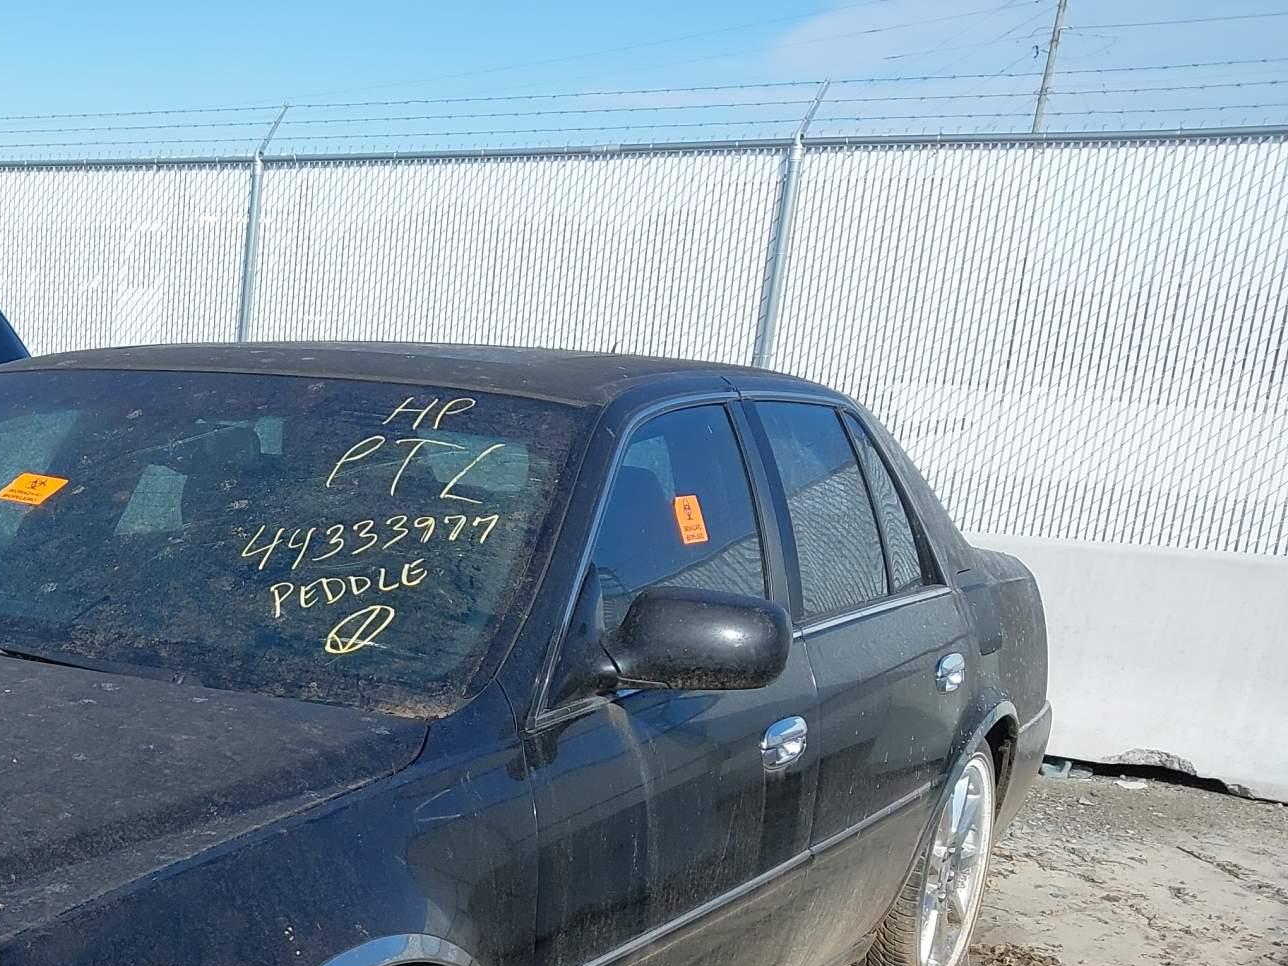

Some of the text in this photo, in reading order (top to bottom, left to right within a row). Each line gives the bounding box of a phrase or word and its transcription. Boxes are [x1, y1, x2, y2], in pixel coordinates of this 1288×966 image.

[382, 397, 476, 430] HP
[241, 514, 500, 570] 44333977
[270, 559, 427, 618] PEDDLE
